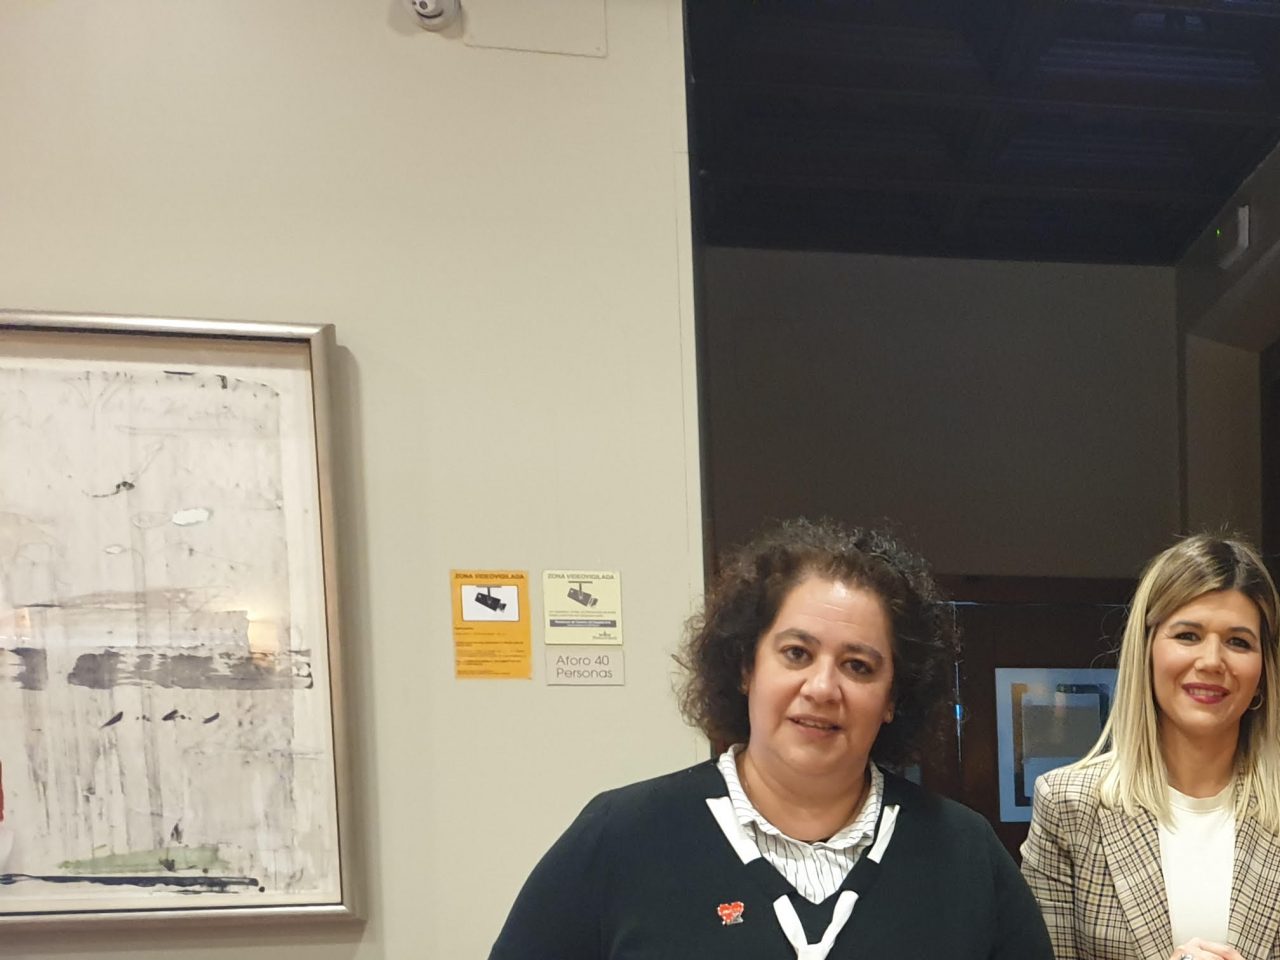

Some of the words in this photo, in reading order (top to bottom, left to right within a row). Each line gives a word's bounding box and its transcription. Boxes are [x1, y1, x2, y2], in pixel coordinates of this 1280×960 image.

[556, 655, 591, 666] Aforo
[594, 655, 610, 666] 40
[556, 668, 612, 679] Personas
